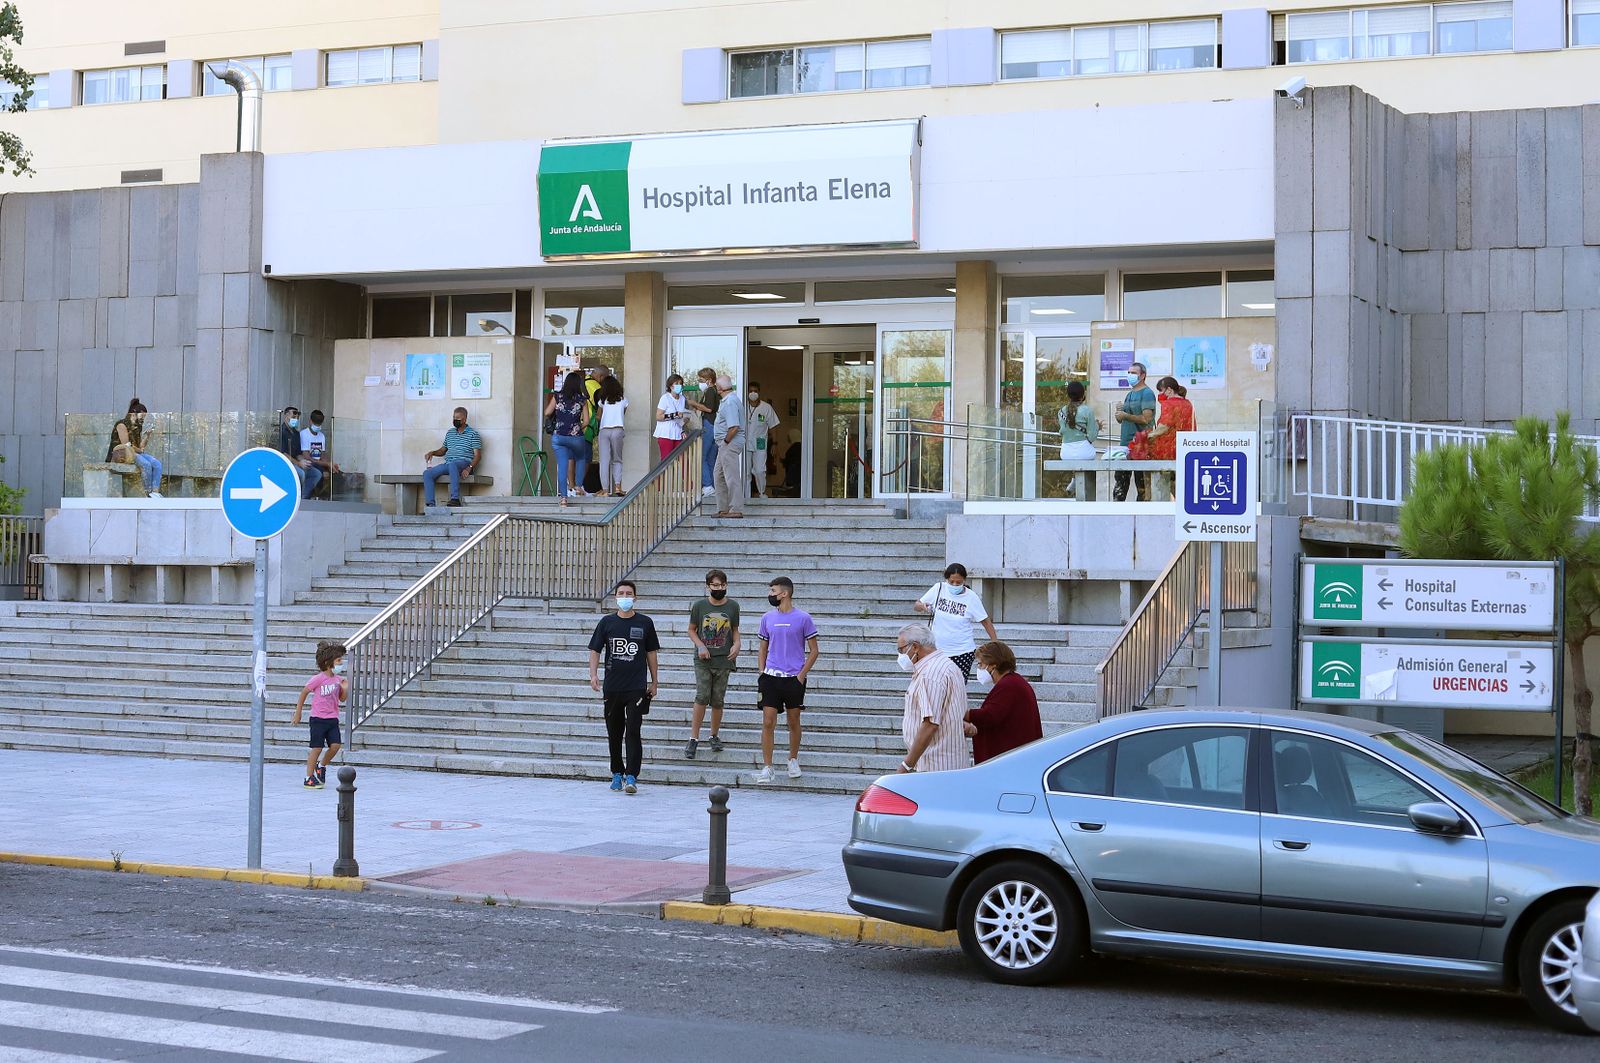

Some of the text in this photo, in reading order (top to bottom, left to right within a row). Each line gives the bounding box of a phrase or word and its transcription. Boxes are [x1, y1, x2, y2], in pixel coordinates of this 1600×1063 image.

[643, 177, 892, 213] Hospital Infanta Elena
[549, 222, 622, 235] Junta de Andalucía
[1183, 438, 1251, 448] Acceso al Hospital
[1200, 521, 1252, 534] Ascensor
[1405, 579, 1456, 595] Hospital
[1405, 597, 1527, 614] Consultas Externas
[612, 637, 639, 656] Be
[1397, 656, 1508, 674] Admisión General
[1433, 676, 1509, 693] URGENCIAS
